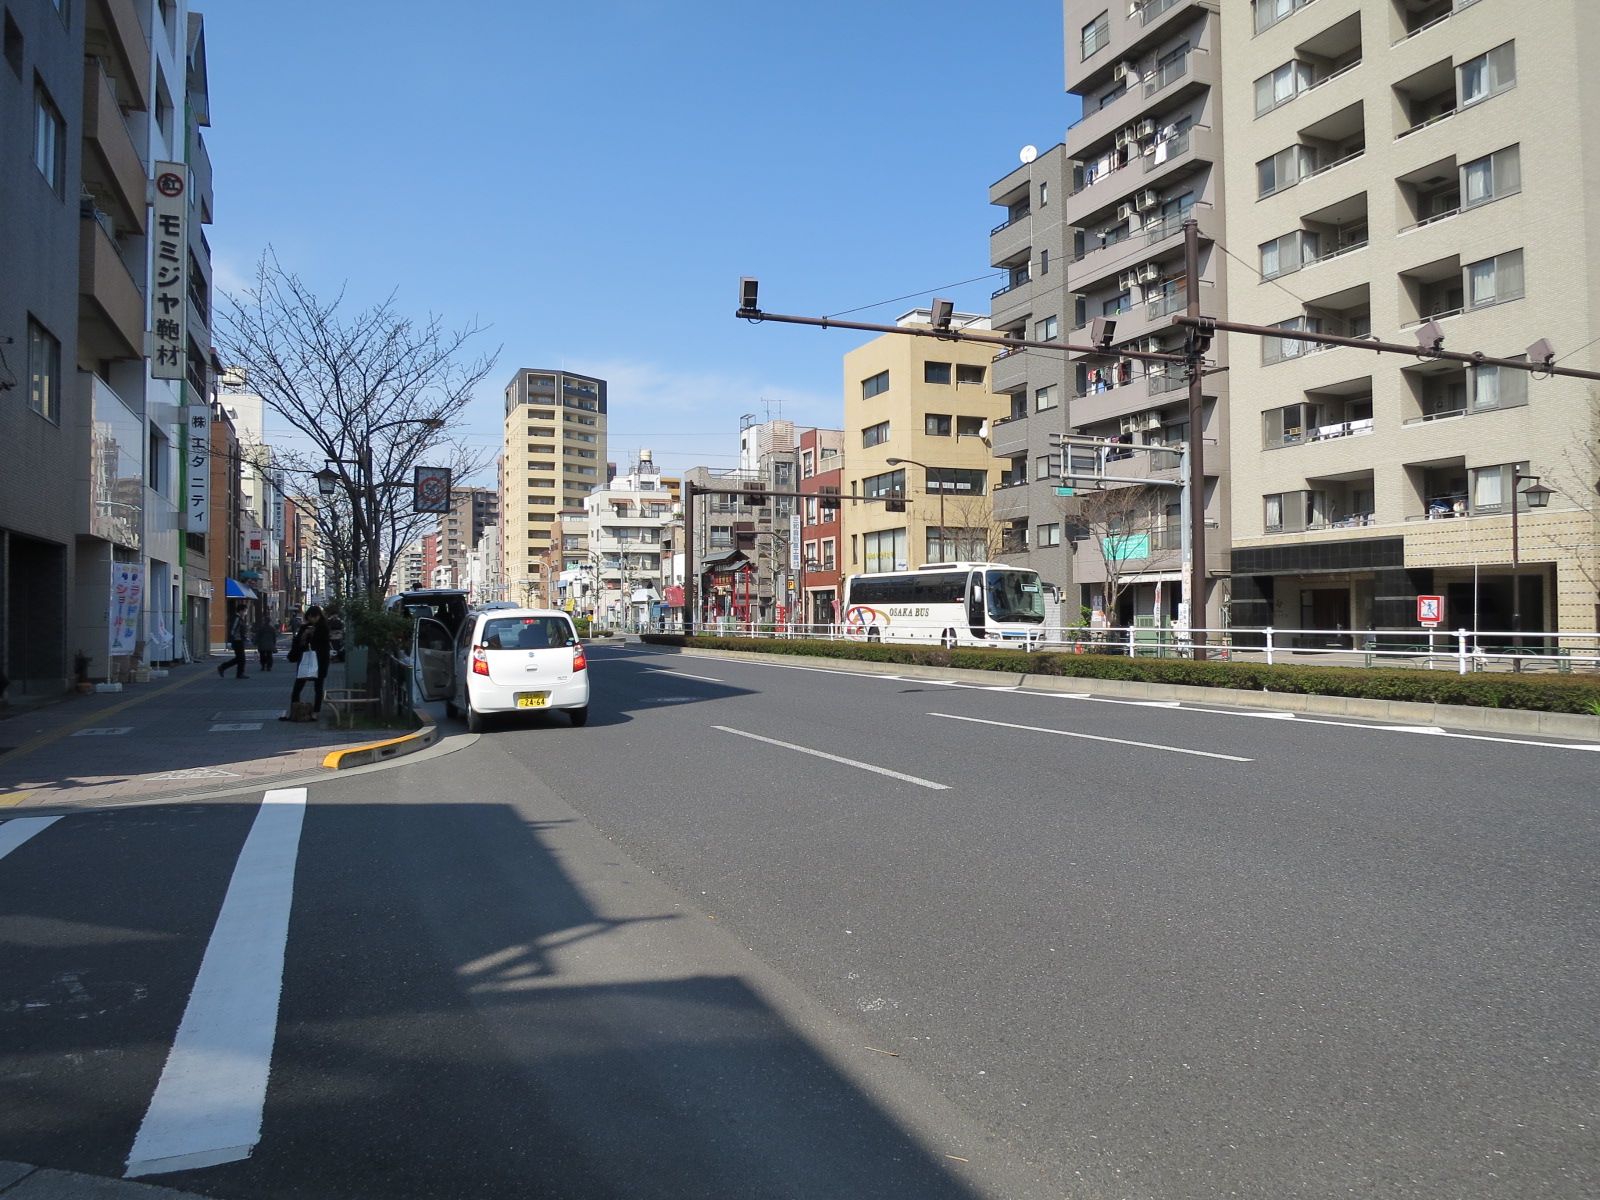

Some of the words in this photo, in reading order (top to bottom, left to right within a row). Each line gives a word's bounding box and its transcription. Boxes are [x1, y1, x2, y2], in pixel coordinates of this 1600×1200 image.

[157, 213, 181, 367] モミジヤ鞄材
[889, 607, 913, 617] OSAKA
[914, 607, 930, 617] BUS
